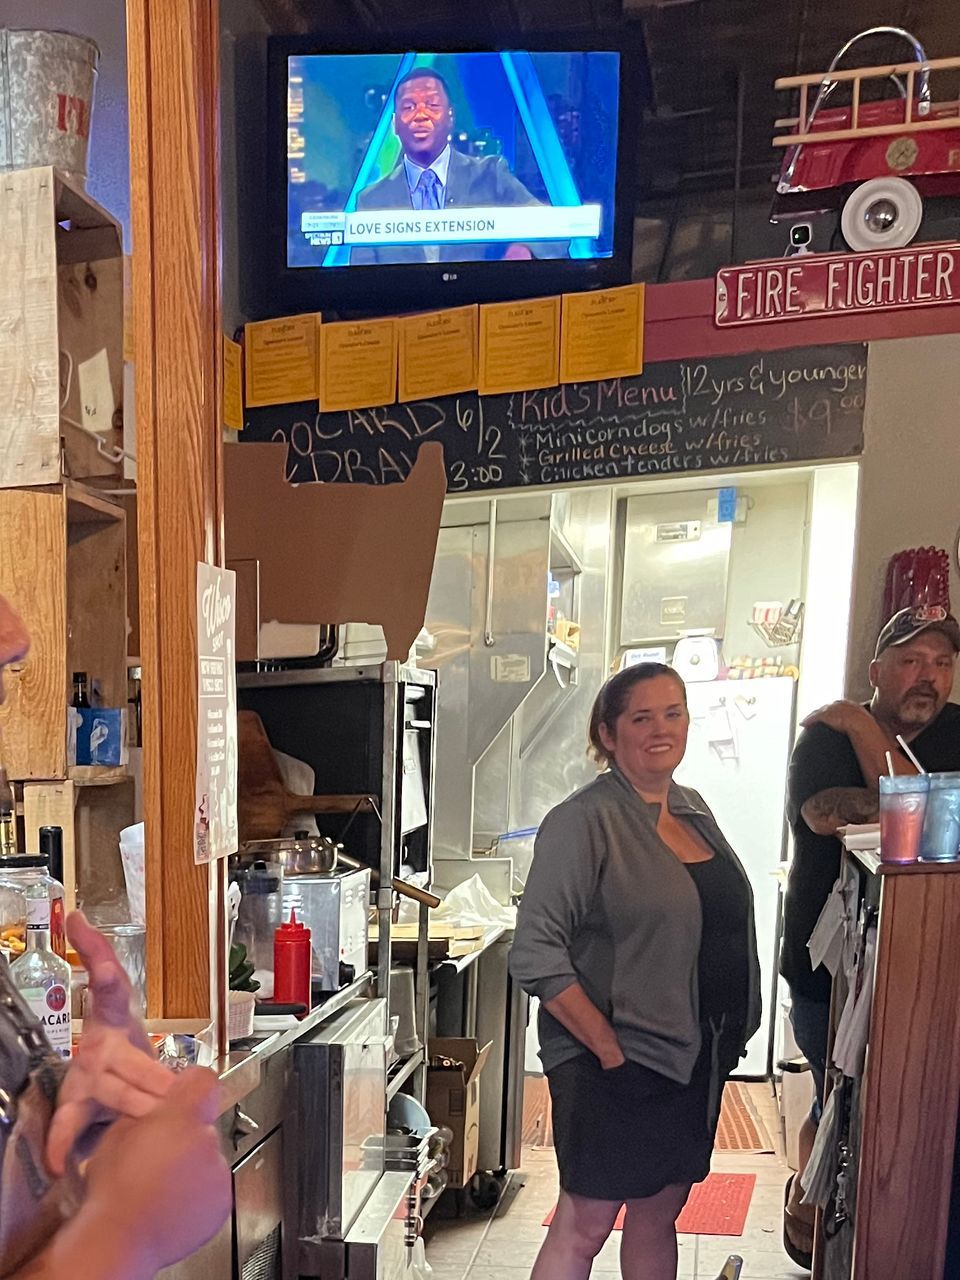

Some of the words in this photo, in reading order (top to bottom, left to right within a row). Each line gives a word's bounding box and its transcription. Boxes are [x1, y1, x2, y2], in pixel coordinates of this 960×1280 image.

[349, 222, 381, 235] LOVE
[385, 221, 422, 234] SIGNS
[425, 219, 495, 232] EXTENSION
[736, 268, 804, 317] FIRE
[827, 252, 955, 308] FIGHTER
[522, 383, 591, 421] Kid's
[596, 377, 678, 412] Menu
[686, 363, 713, 397] 12
[711, 377, 745, 406] yrs
[768, 364, 867, 400] younger
[315, 401, 446, 441] CARD
[538, 444, 604, 467] Grilled
[621, 450, 702, 474] tenders
[449, 460, 503, 491] 3:00
[40, 1011, 70, 1026] ACAR
